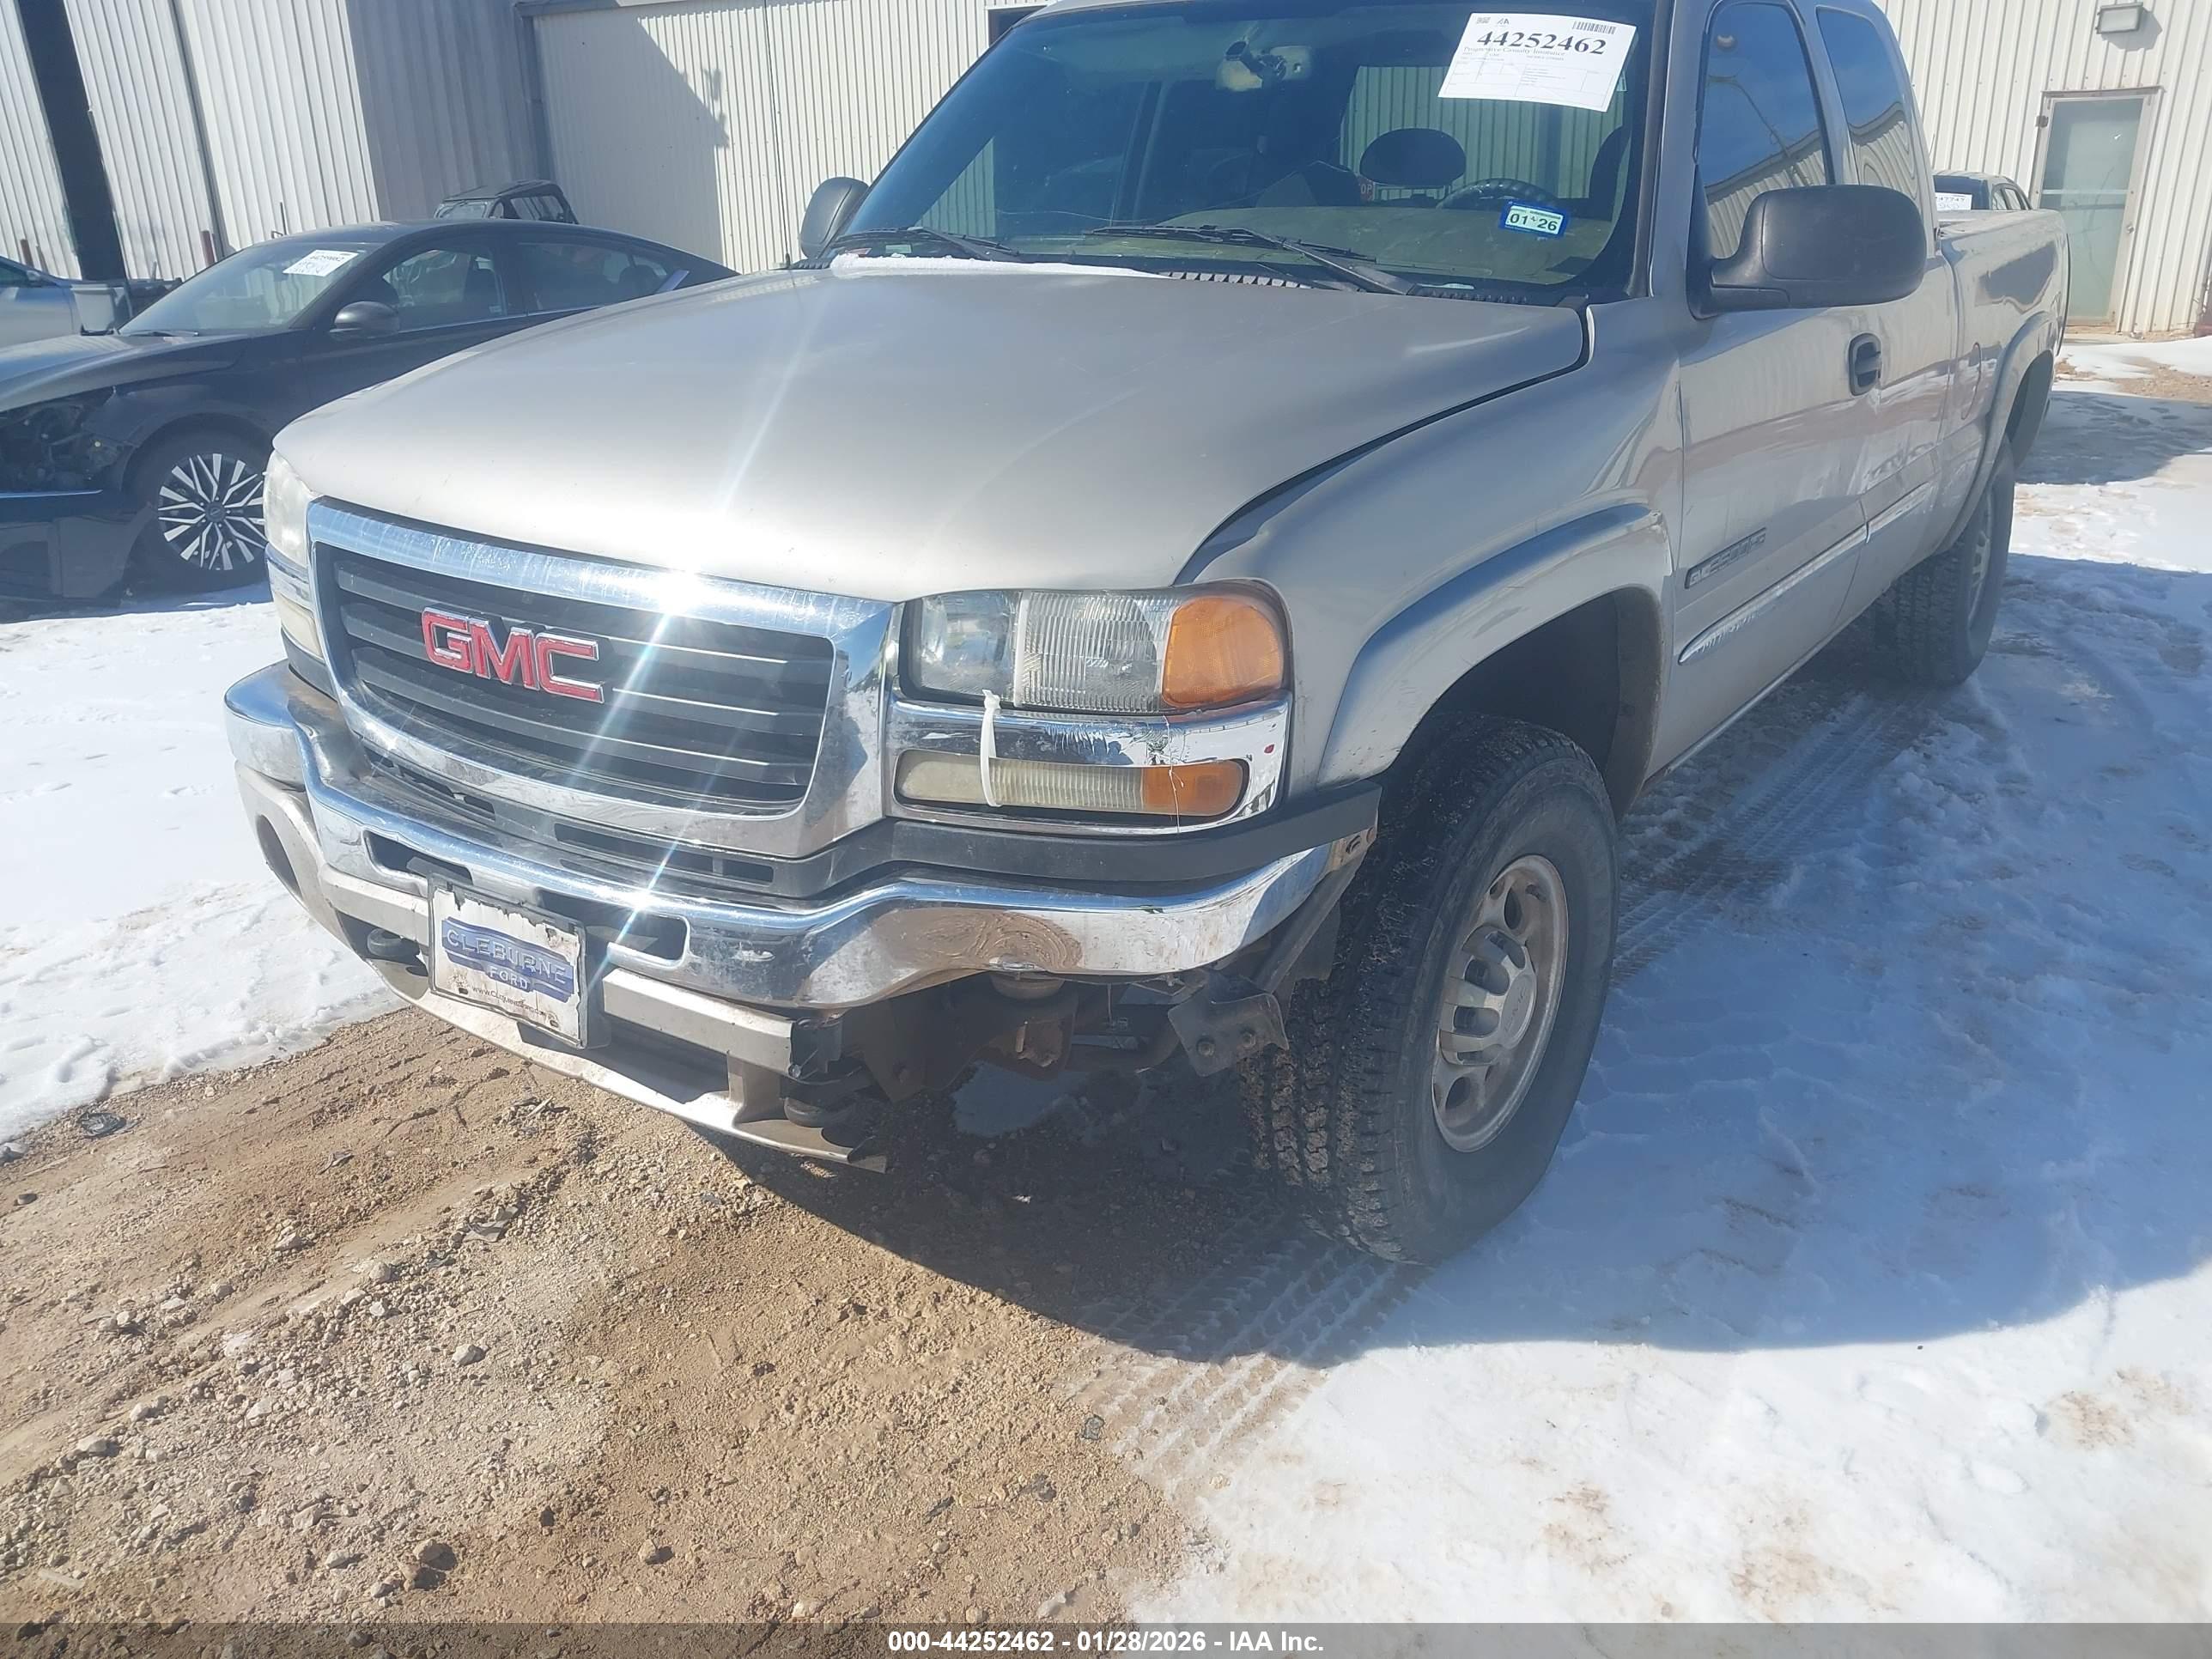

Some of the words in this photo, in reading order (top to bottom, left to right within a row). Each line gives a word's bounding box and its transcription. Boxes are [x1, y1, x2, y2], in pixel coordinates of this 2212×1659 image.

[1477, 30, 1607, 56] 44252462
[1510, 213, 1528, 225] 01
[1537, 218, 1558, 231] 26
[422, 606, 605, 704] GMC
[447, 928, 567, 985] CLEBURNE
[489, 965, 529, 990] FORD
